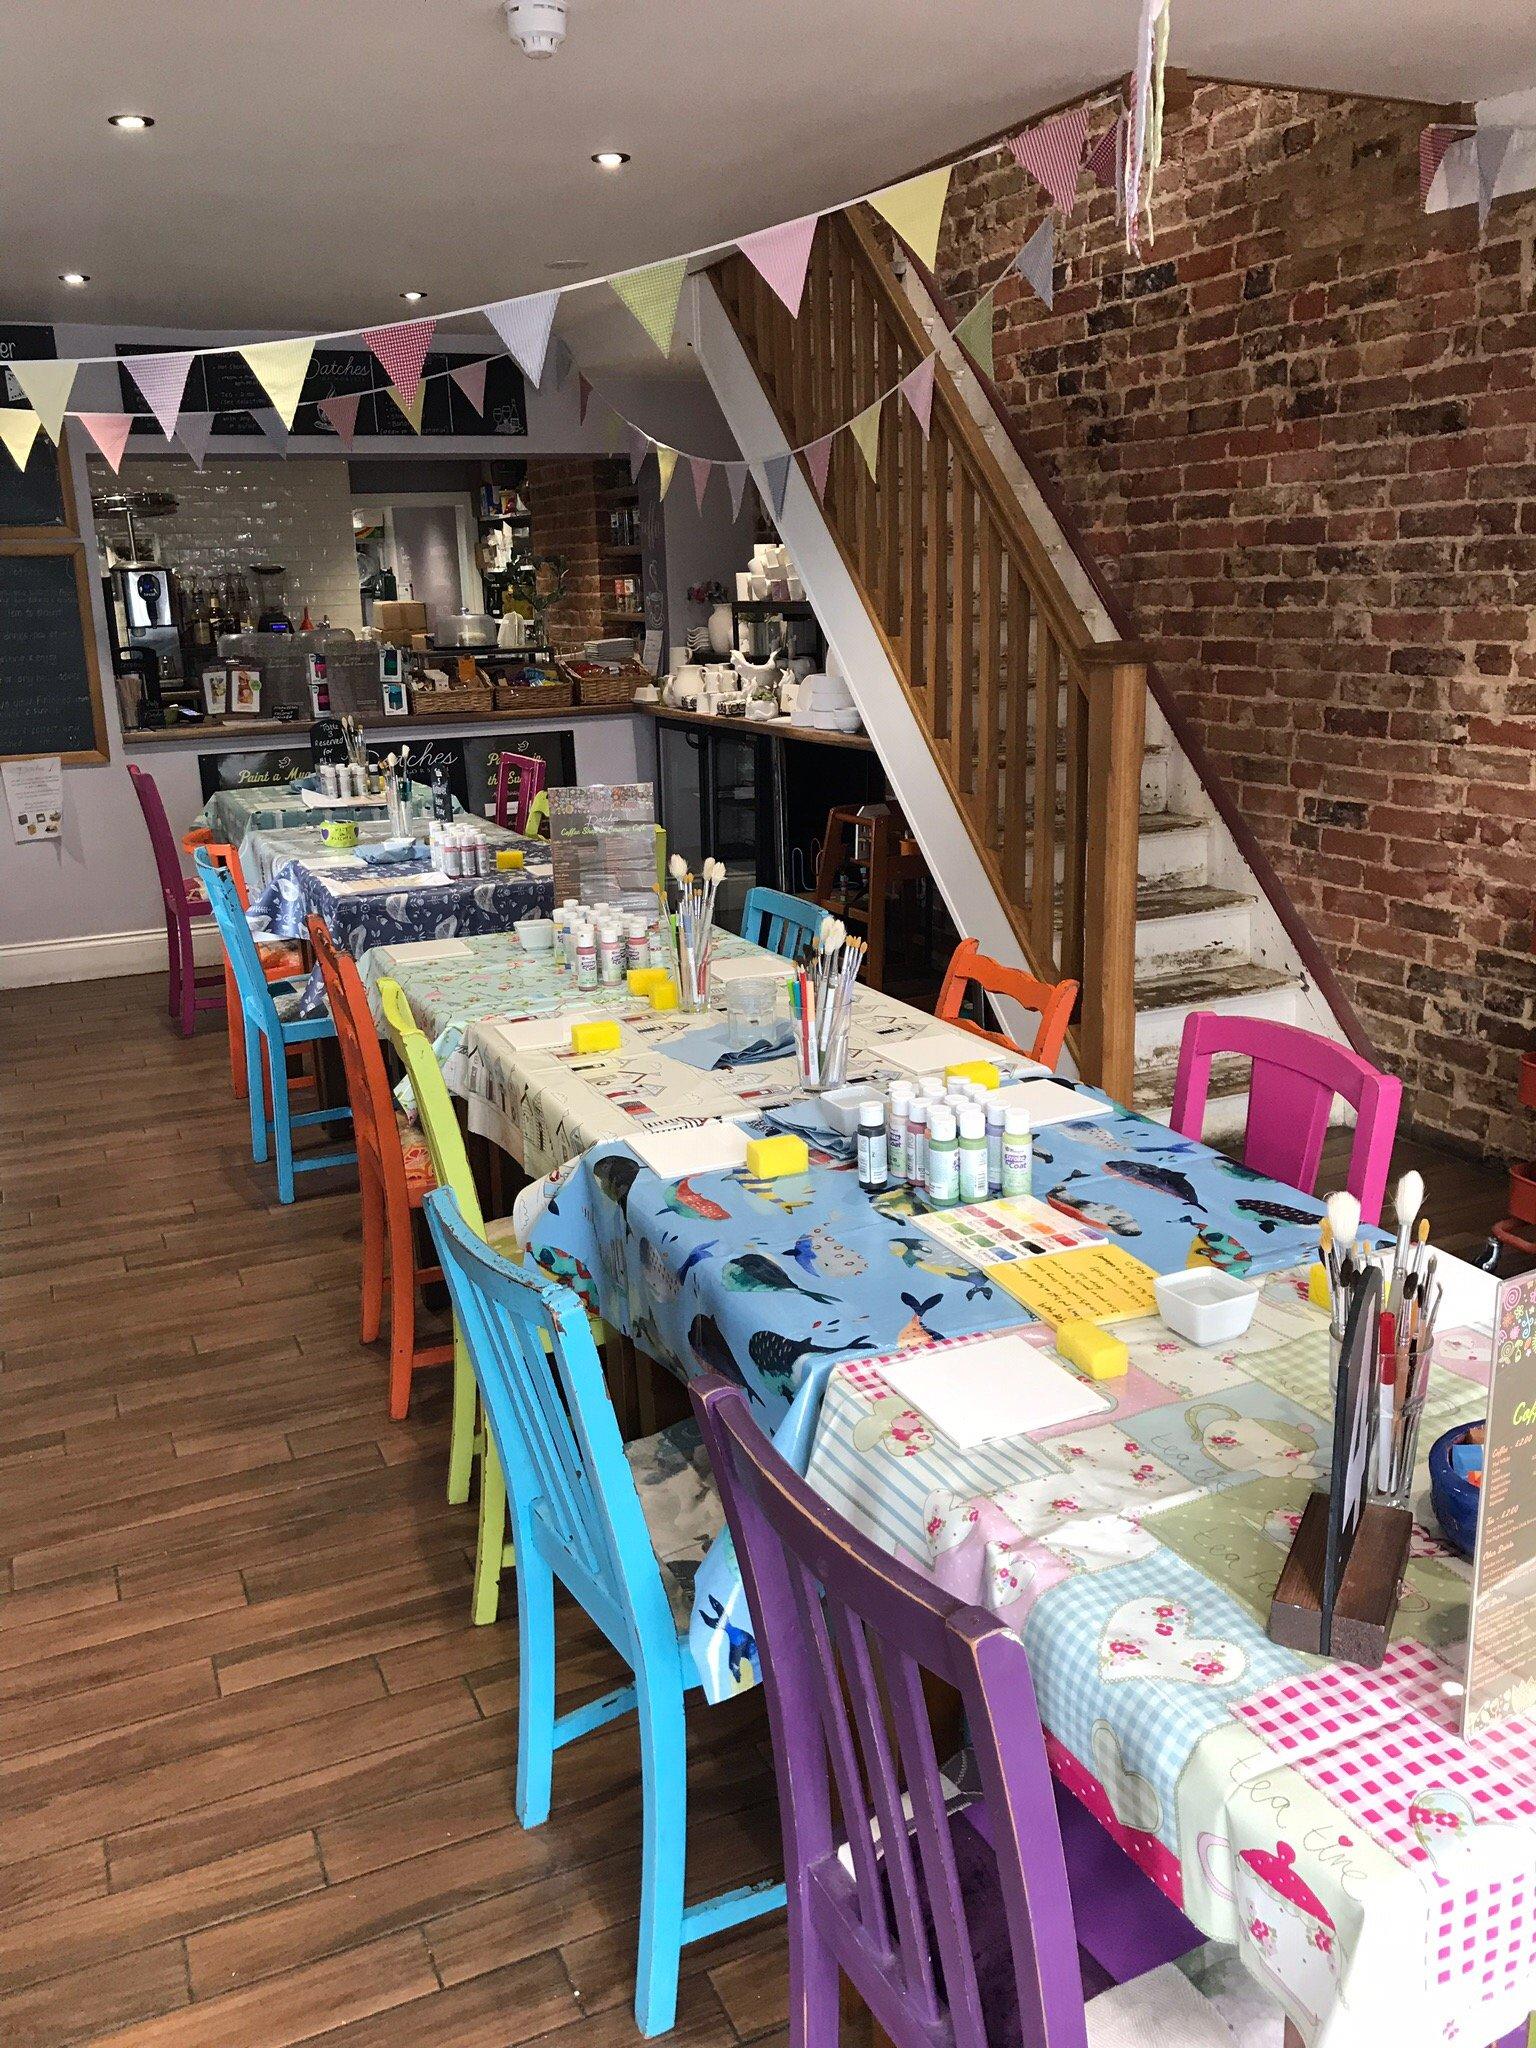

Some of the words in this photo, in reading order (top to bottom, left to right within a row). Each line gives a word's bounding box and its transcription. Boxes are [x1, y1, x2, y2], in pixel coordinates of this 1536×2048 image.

[238, 769, 269, 784] Paint
[272, 773, 281, 781] a
[1230, 1752, 1291, 1829] tea
[1303, 1824, 1368, 1901] time
